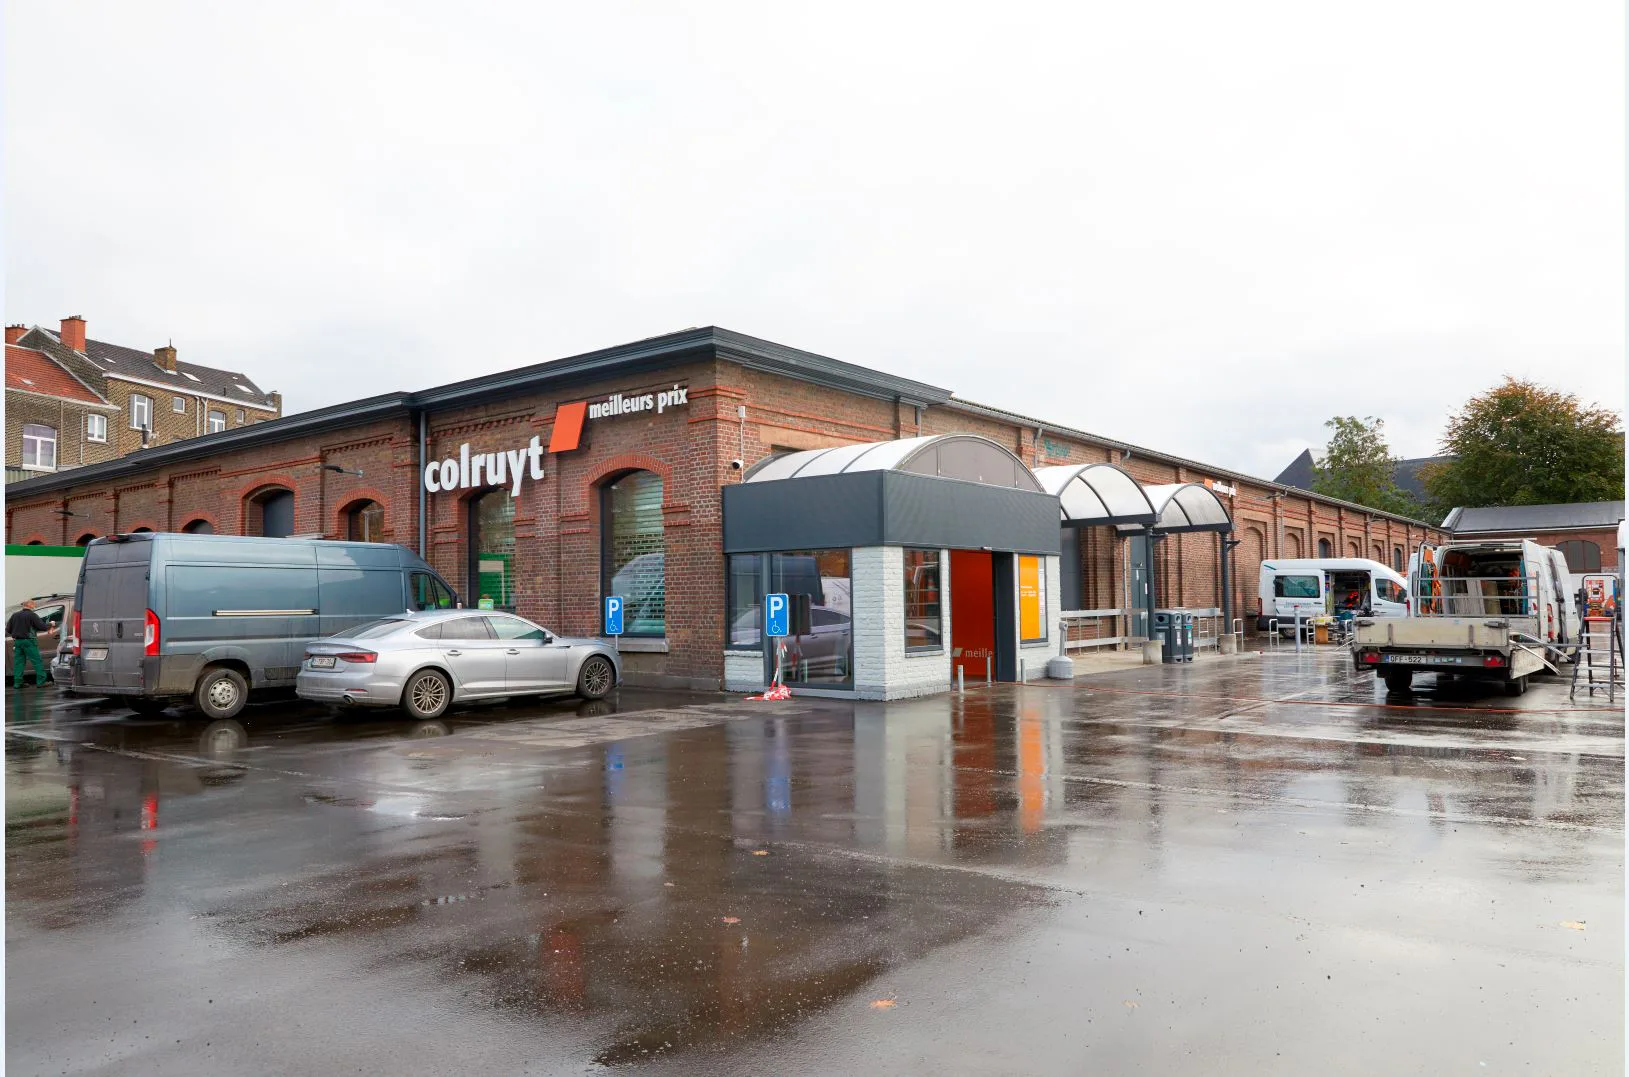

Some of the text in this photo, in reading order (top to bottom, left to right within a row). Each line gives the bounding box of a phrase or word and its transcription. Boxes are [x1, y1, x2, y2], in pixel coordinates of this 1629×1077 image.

[589, 384, 689, 419] meilleurs prix
[424, 435, 545, 498] colruyt
[608, 599, 620, 619] P
[770, 596, 784, 619] P
